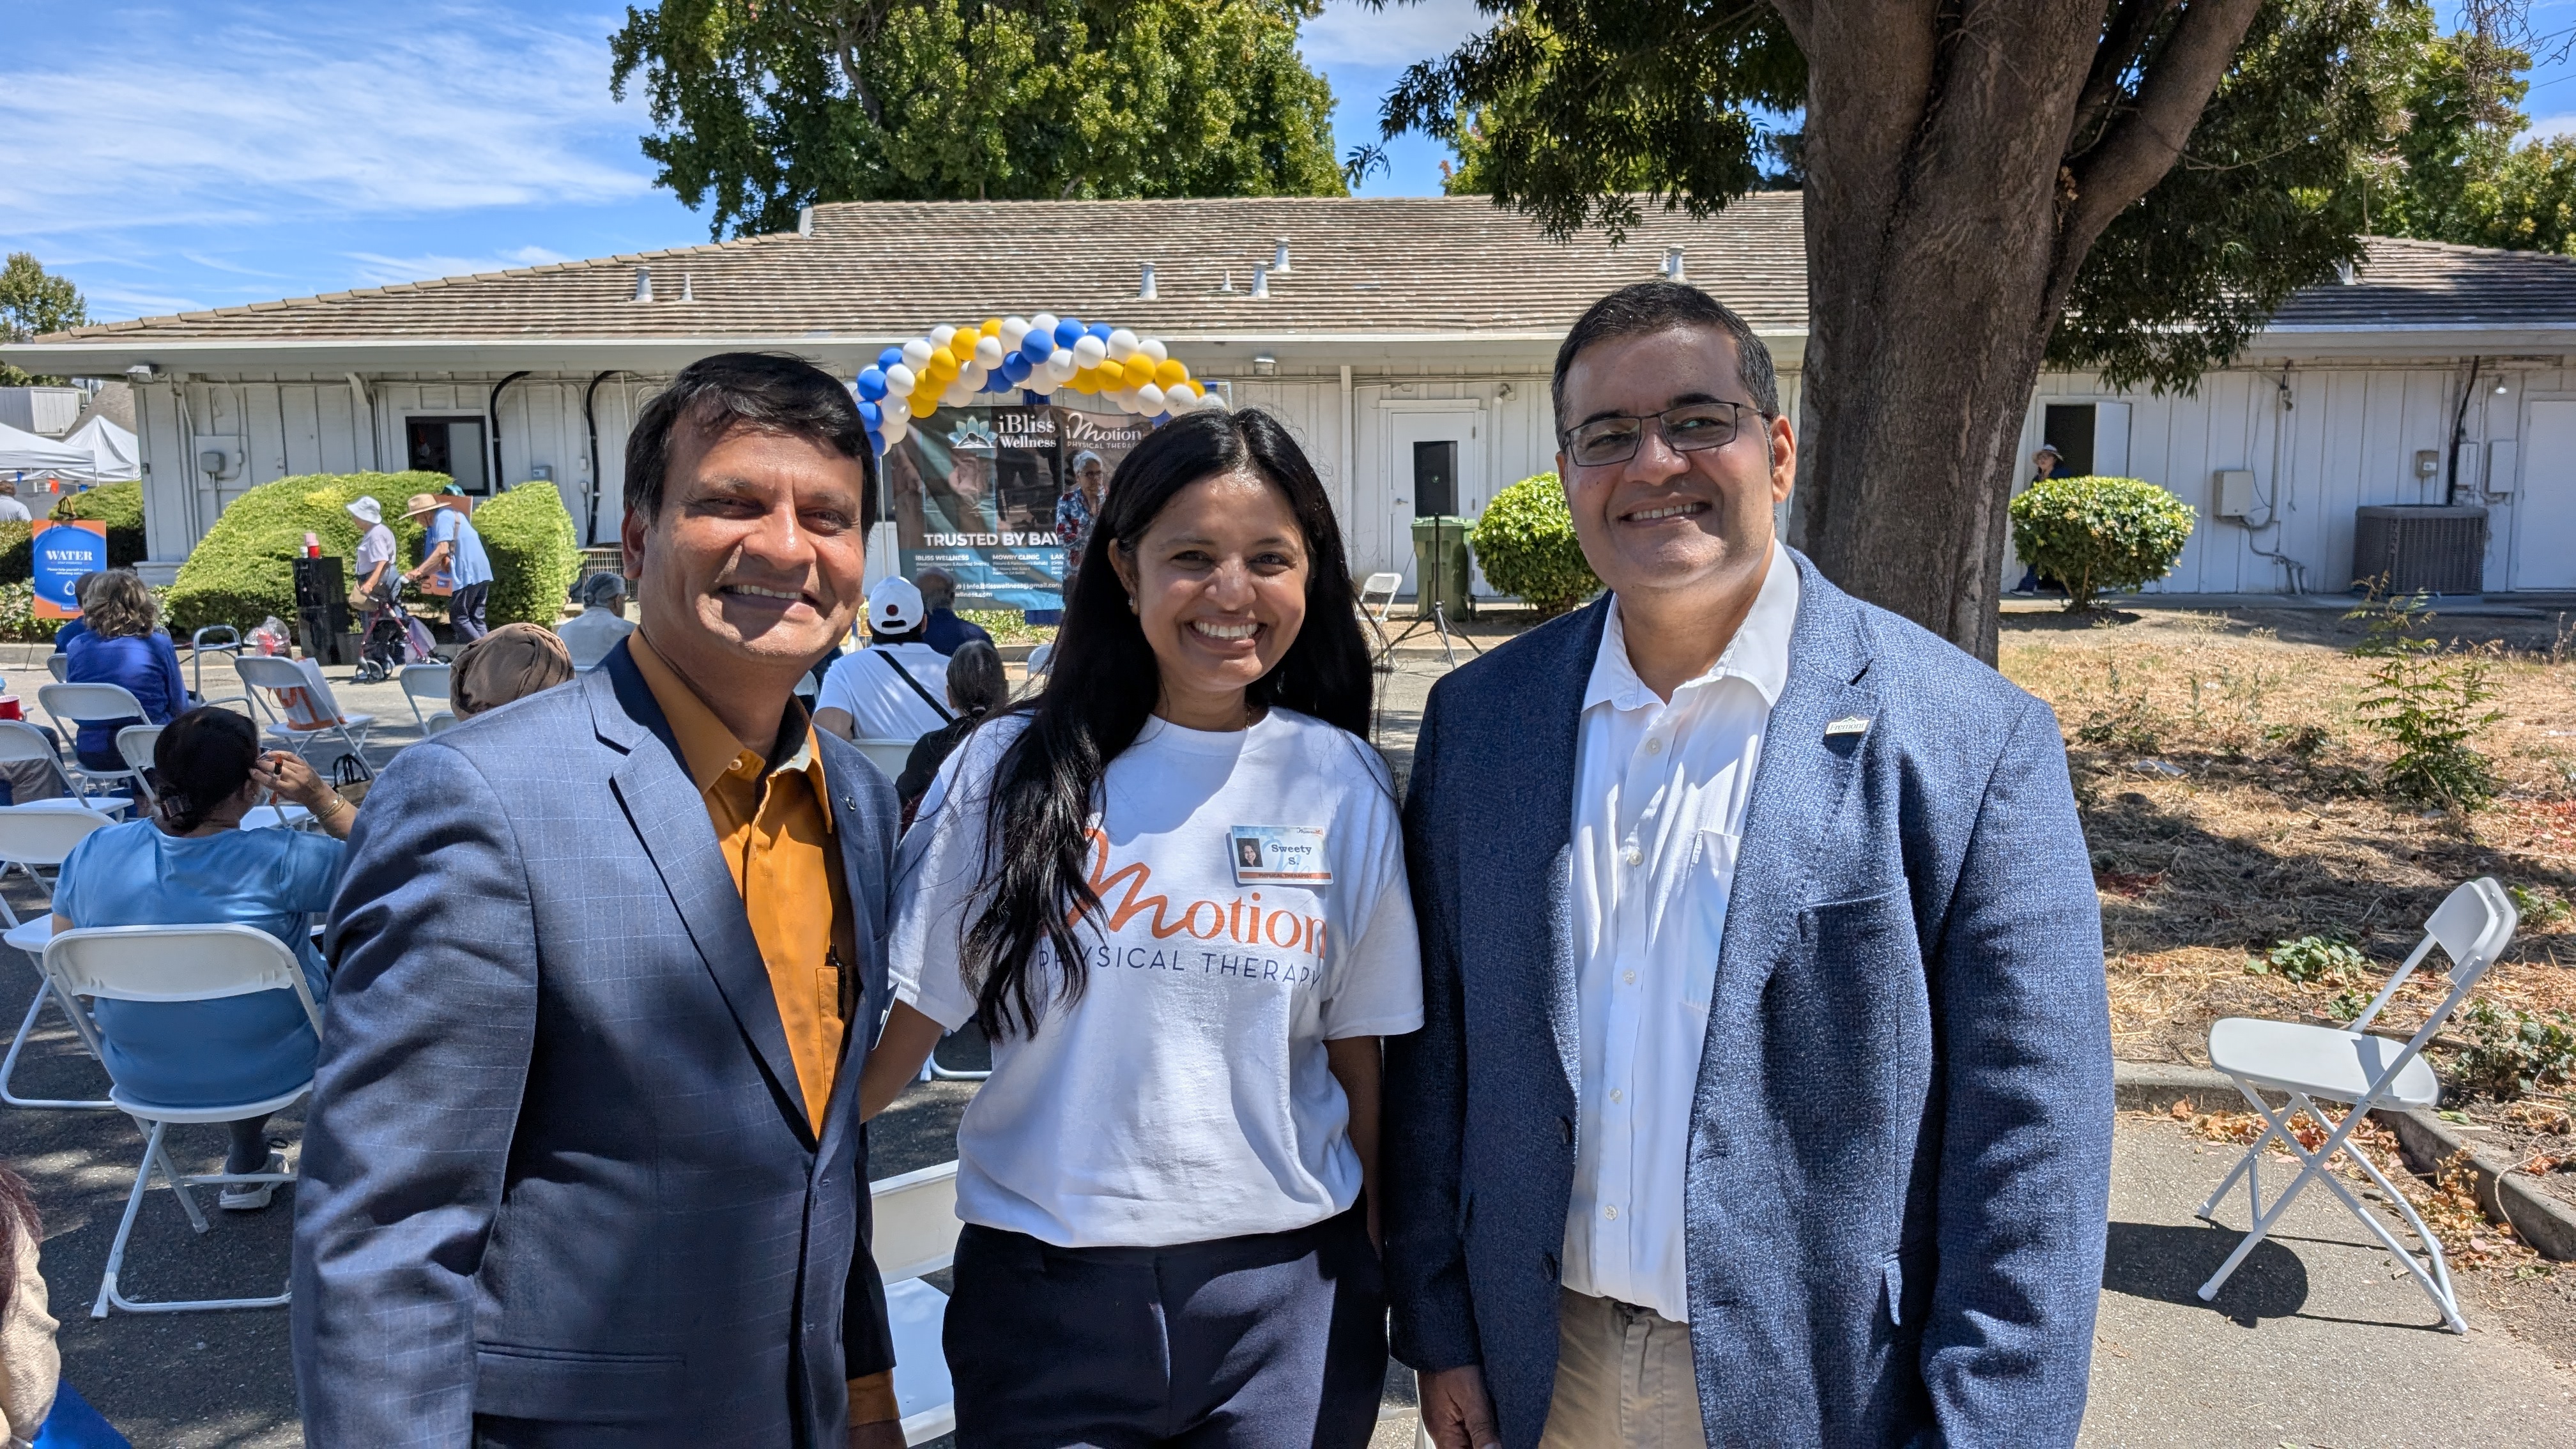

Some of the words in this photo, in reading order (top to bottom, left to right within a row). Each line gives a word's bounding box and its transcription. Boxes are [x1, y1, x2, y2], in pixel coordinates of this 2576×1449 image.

[998, 413, 1056, 434] iBliss
[1065, 412, 1142, 441] iMotion
[999, 433, 1057, 448] Wellness
[1068, 441, 1104, 449] PHYSICAL
[924, 533, 998, 546] TRUSTED
[1002, 532, 1025, 546] BY
[1029, 532, 1059, 546] BAY
[46, 550, 93, 561] WATER
[1271, 844, 1312, 855] Sweety
[1288, 857, 1300, 866] S.
[1040, 827, 1327, 960] Motion
[1202, 953, 1321, 991] THERAPY
